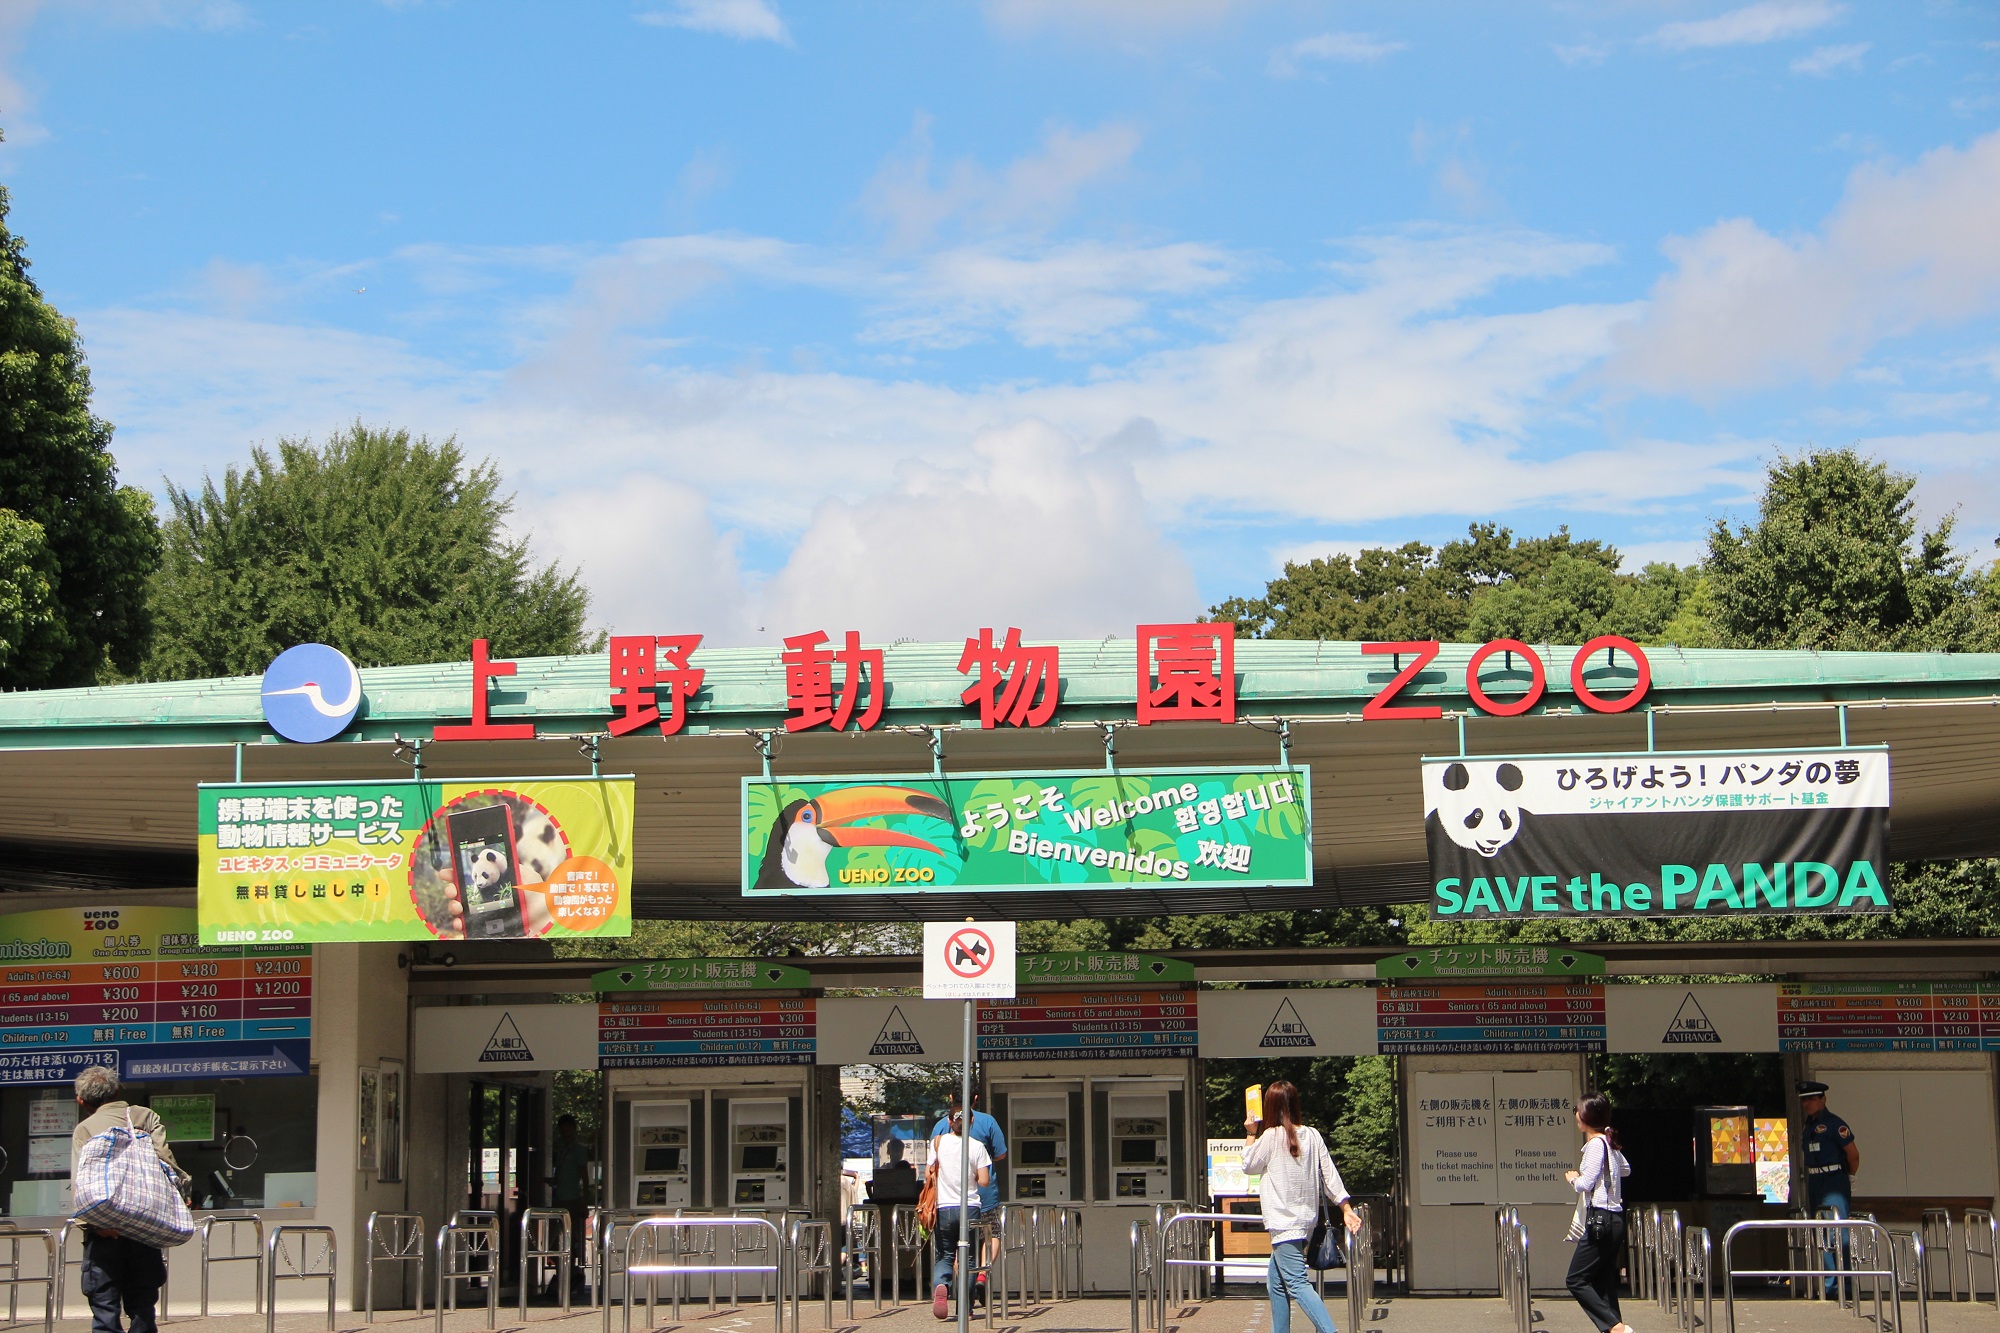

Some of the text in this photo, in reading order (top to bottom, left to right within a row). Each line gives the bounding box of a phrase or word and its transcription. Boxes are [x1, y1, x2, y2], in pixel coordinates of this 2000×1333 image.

[433, 622, 1652, 741] 上野動物園 ZOO
[1172, 777, 1297, 834] 환영합니다
[1589, 793, 1829, 810] ジャイアントパンダ保護サポート基金
[218, 796, 402, 822] 携帯端末を使った
[1063, 780, 1199, 835] Welcome
[959, 787, 1065, 839] ようこそ
[218, 822, 402, 847] 動物情報サービス
[1007, 829, 1191, 880] Bienvenidos
[1194, 838, 1252, 873] 欢迎
[218, 854, 402, 871] ユビキタス・コミュニケータ
[839, 867, 934, 884] UENO ZOO
[1436, 860, 1889, 915] SAVE the PANDA
[554, 896, 612, 905] 動物園がもっと
[84, 920, 119, 930] ZOO
[217, 928, 293, 941] UENO ZOO
[105, 936, 140, 947] 個人券
[113, 948, 129, 956] day
[1428, 948, 1549, 965] チケット販売機
[256, 961, 300, 974] ¥2400
[1024, 956, 1140, 972] チケット販売機
[7, 966, 139, 981] Adults (16-64) ¥600
[182, 963, 217, 976] ¥480
[642, 963, 757, 979] チケット販売機
[182, 984, 217, 997] ¥240
[255, 982, 300, 995] ¥1200
[1485, 987, 1591, 997] Adults (16-64) ¥600
[23, 992, 38, 1002] and
[40, 991, 70, 1002] above)
[103, 987, 139, 999] ¥300
[1159, 994, 1184, 1002] ¥600
[779, 1001, 803, 1009] ¥600
[1448, 1003, 1479, 1011] Seniors
[1502, 1003, 1517, 1011] and
[1520, 1002, 1547, 1011] above)
[1566, 1001, 1592, 1010] ¥300
[1896, 998, 1922, 1006] ¥600
[1942, 998, 1968, 1006] ¥480
[181, 1004, 217, 1017] ¥160
[1160, 1007, 1184, 1016] ¥300
[1383, 1004, 1394, 1012] 65
[36, 1012, 69, 1022] (13-15)
[103, 1008, 138, 1020] ¥200
[780, 1014, 803, 1023] ¥300
[1475, 1015, 1592, 1025] Students (13-15) ¥200
[1897, 1012, 1923, 1021] ¥300
[1943, 1012, 1969, 1020] ¥240
[1072, 1021, 1185, 1031] Students (13-15) ¥200
[1383, 1017, 1407, 1026] 中学生
[1675, 1019, 1706, 1029] 入場口
[172, 1026, 225, 1038] 無料 Free
[693, 1028, 803, 1038] Students (13-15) ¥200
[982, 1024, 1006, 1033] 中学生
[1272, 1024, 1302, 1034] 入場口
[1483, 1029, 1548, 1038] Children (0-12)
[1559, 1028, 1576, 1037] 無料
[1898, 1027, 1923, 1035] ¥200
[1944, 1026, 1970, 1035] ¥160
[2, 1032, 68, 1043] Children (0-12)
[93, 1029, 146, 1041] 無料 Free
[604, 1031, 627, 1040] 中学生
[882, 1031, 911, 1042] 入場口
[1153, 1034, 1192, 1043] 無料 Free
[1667, 1033, 1716, 1042] ENTRANCE
[491, 1038, 522, 1048] 入場口
[772, 1041, 788, 1050] 無料
[1263, 1037, 1311, 1046] ENTRANCE
[873, 1045, 920, 1054] ENTRANCE
[483, 1052, 529, 1060] ENTRANCE
[1420, 1099, 1491, 1111] 左側の販売機を
[1498, 1098, 1570, 1110] 左側の販売機を
[1426, 1116, 1487, 1127] ご利用下さい
[1505, 1115, 1566, 1126] ご利用下さい
[1436, 1150, 1462, 1158] Please
[1436, 1162, 1458, 1170] ticket
